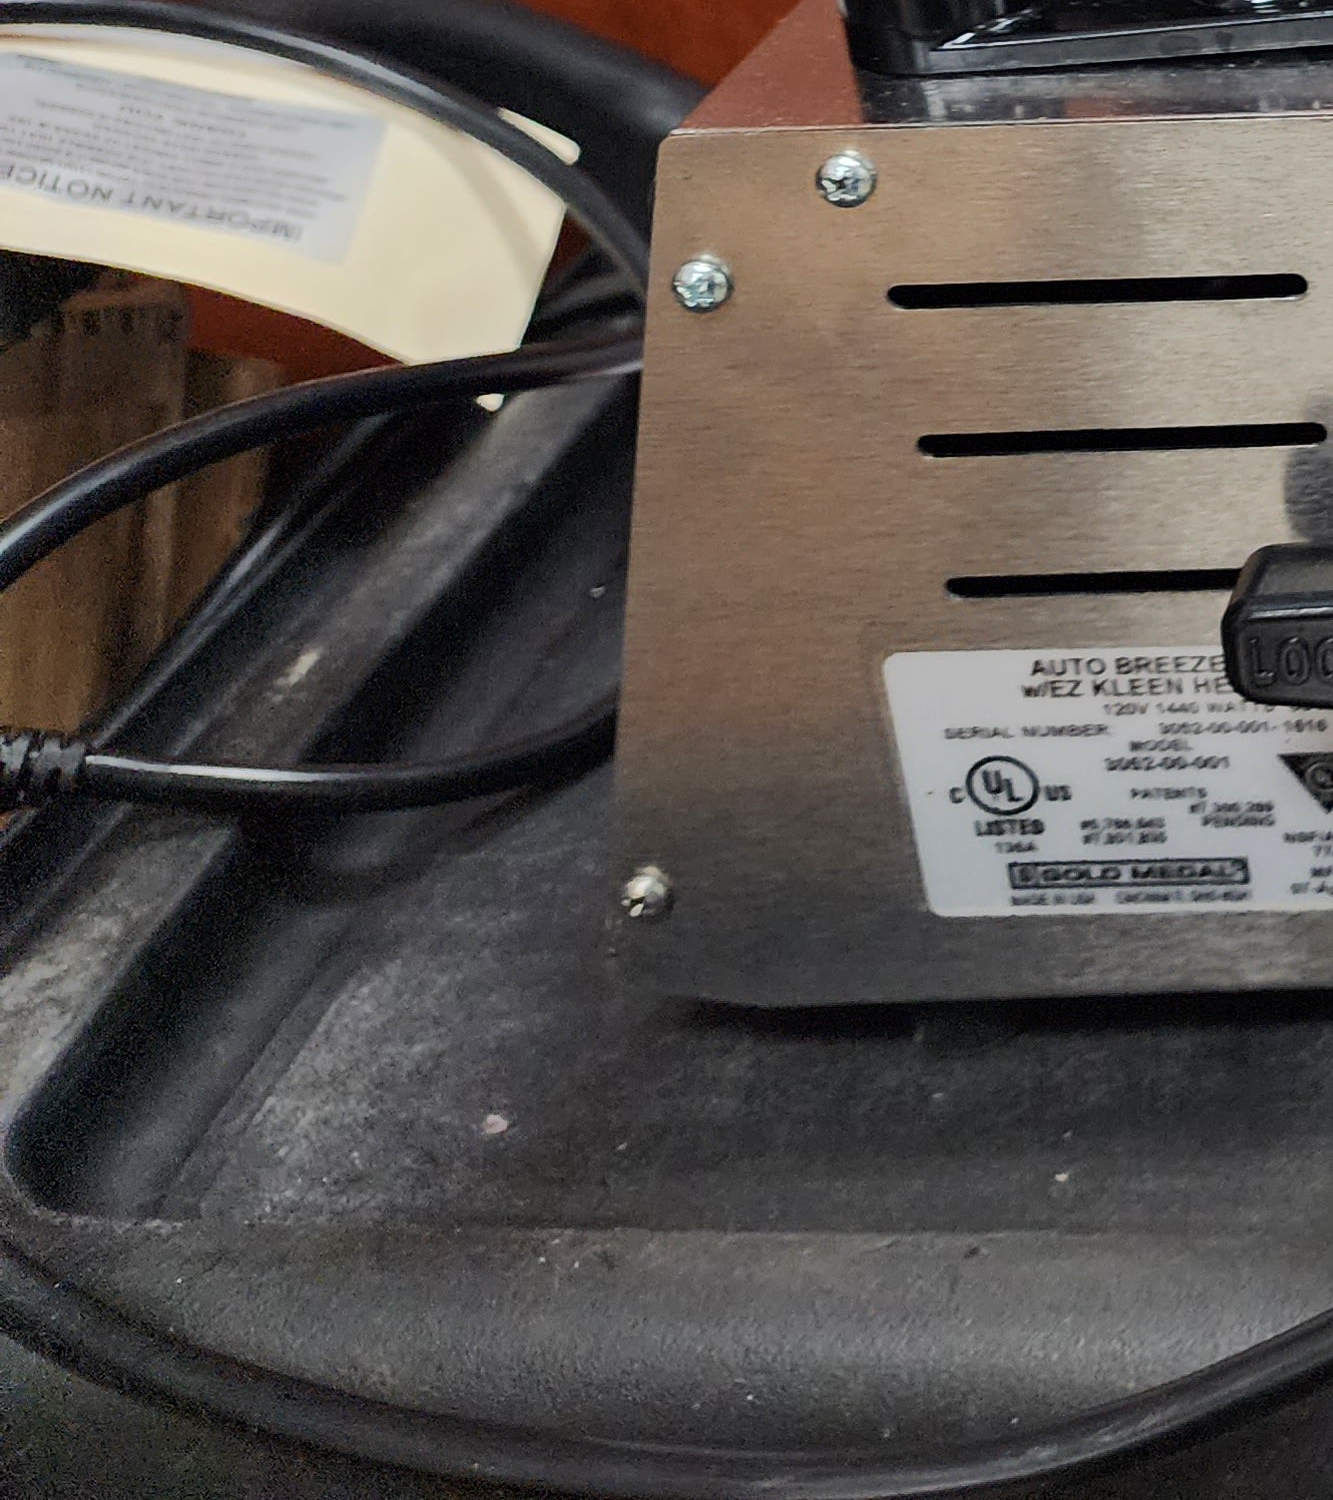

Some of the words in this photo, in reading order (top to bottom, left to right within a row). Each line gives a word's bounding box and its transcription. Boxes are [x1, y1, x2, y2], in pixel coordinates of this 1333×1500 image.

[126, 189, 304, 244] IMPORTANT
[1030, 657, 1106, 677] AUTO
[1091, 677, 1184, 697] KLEEN
[944, 725, 1016, 741] SERIAL
[1021, 722, 1112, 739] NUMBER
[1129, 738, 1193, 752] MODEL
[1130, 786, 1208, 801] PATENTS
[975, 818, 1045, 837] LISTED
[1040, 865, 1122, 882] GOLD
